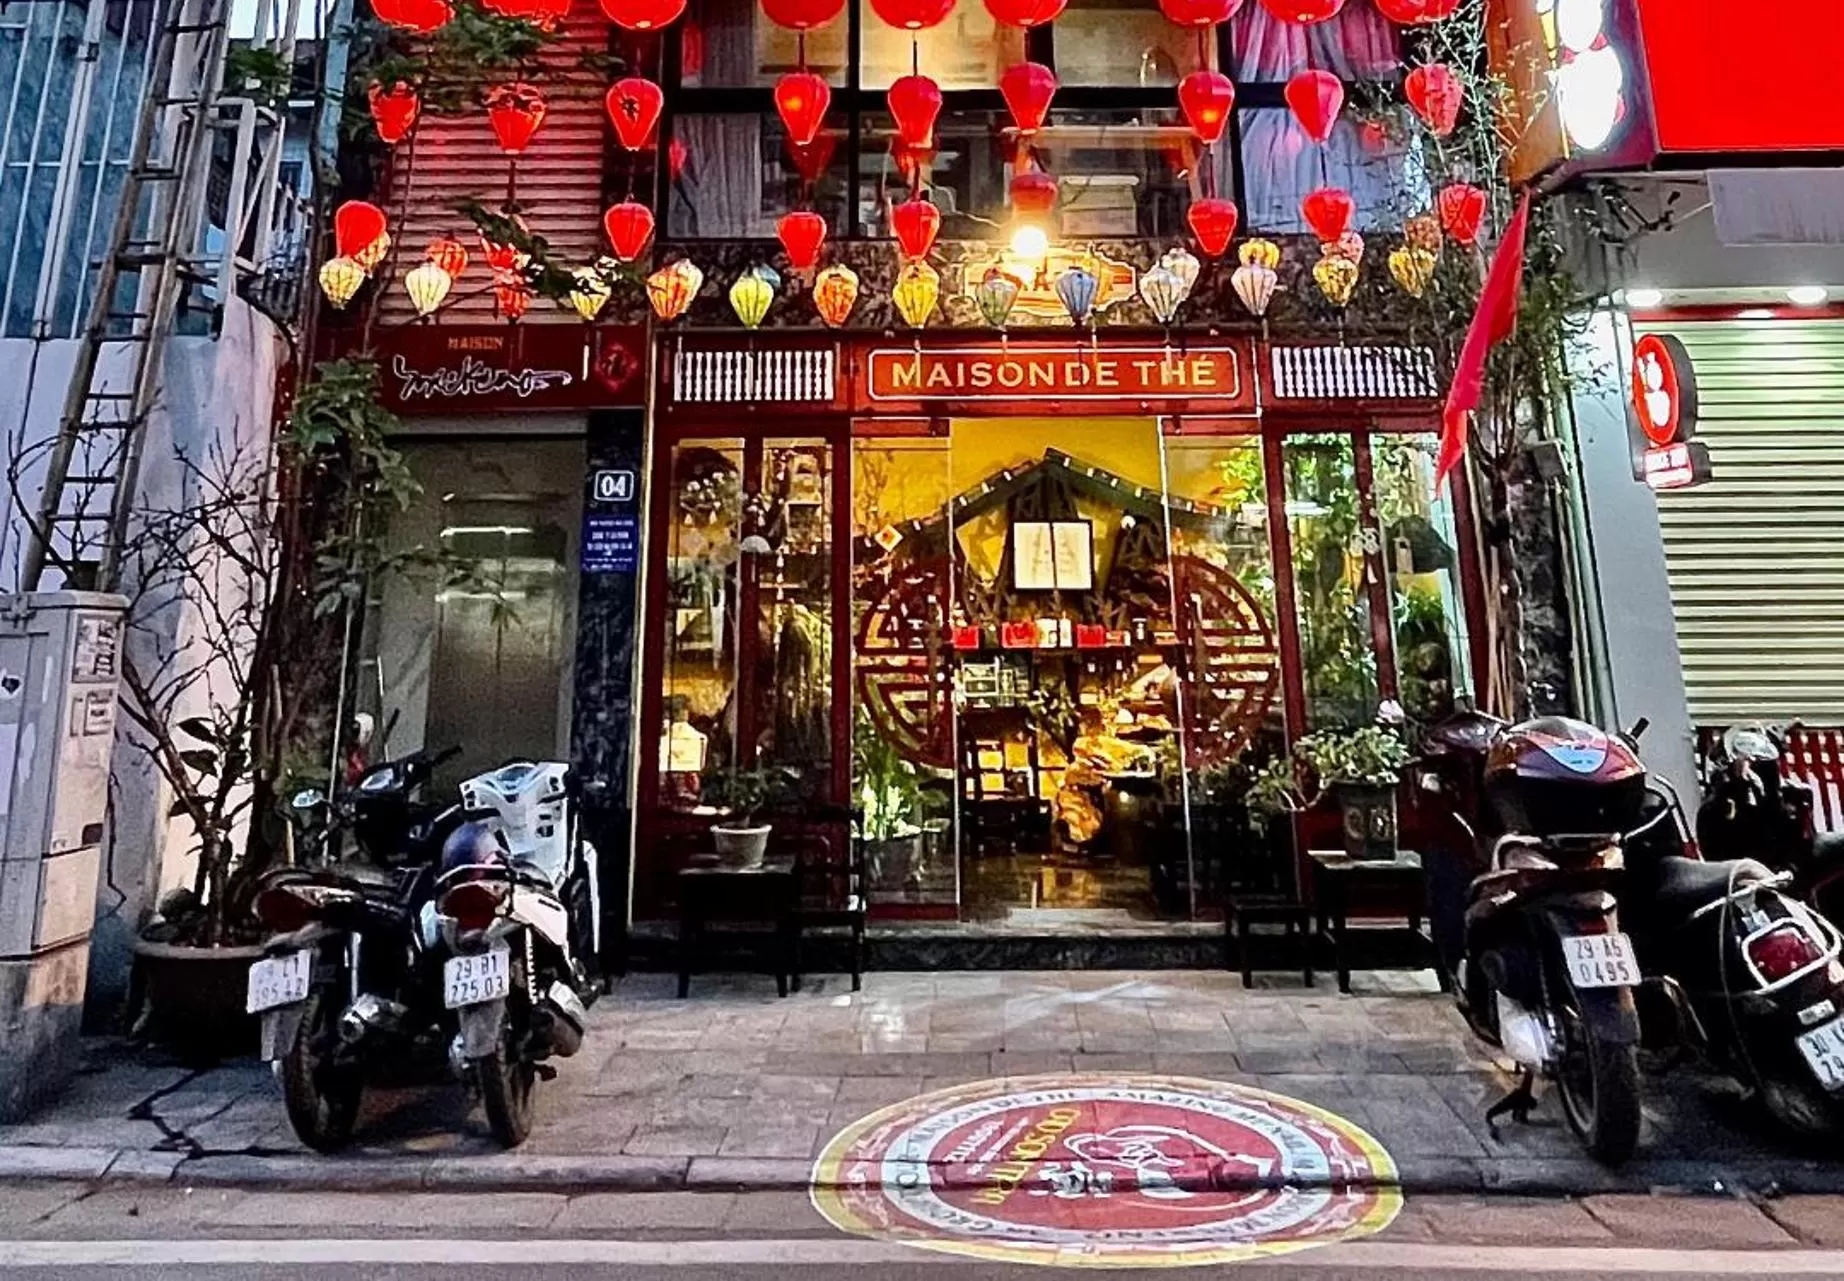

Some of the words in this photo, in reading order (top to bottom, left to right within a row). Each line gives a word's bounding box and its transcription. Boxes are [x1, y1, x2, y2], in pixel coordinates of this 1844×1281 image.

[892, 361, 1055, 388] MAISON
[1064, 361, 1120, 387] DE
[1131, 354, 1217, 386] THÉ
[601, 475, 626, 497] 04
